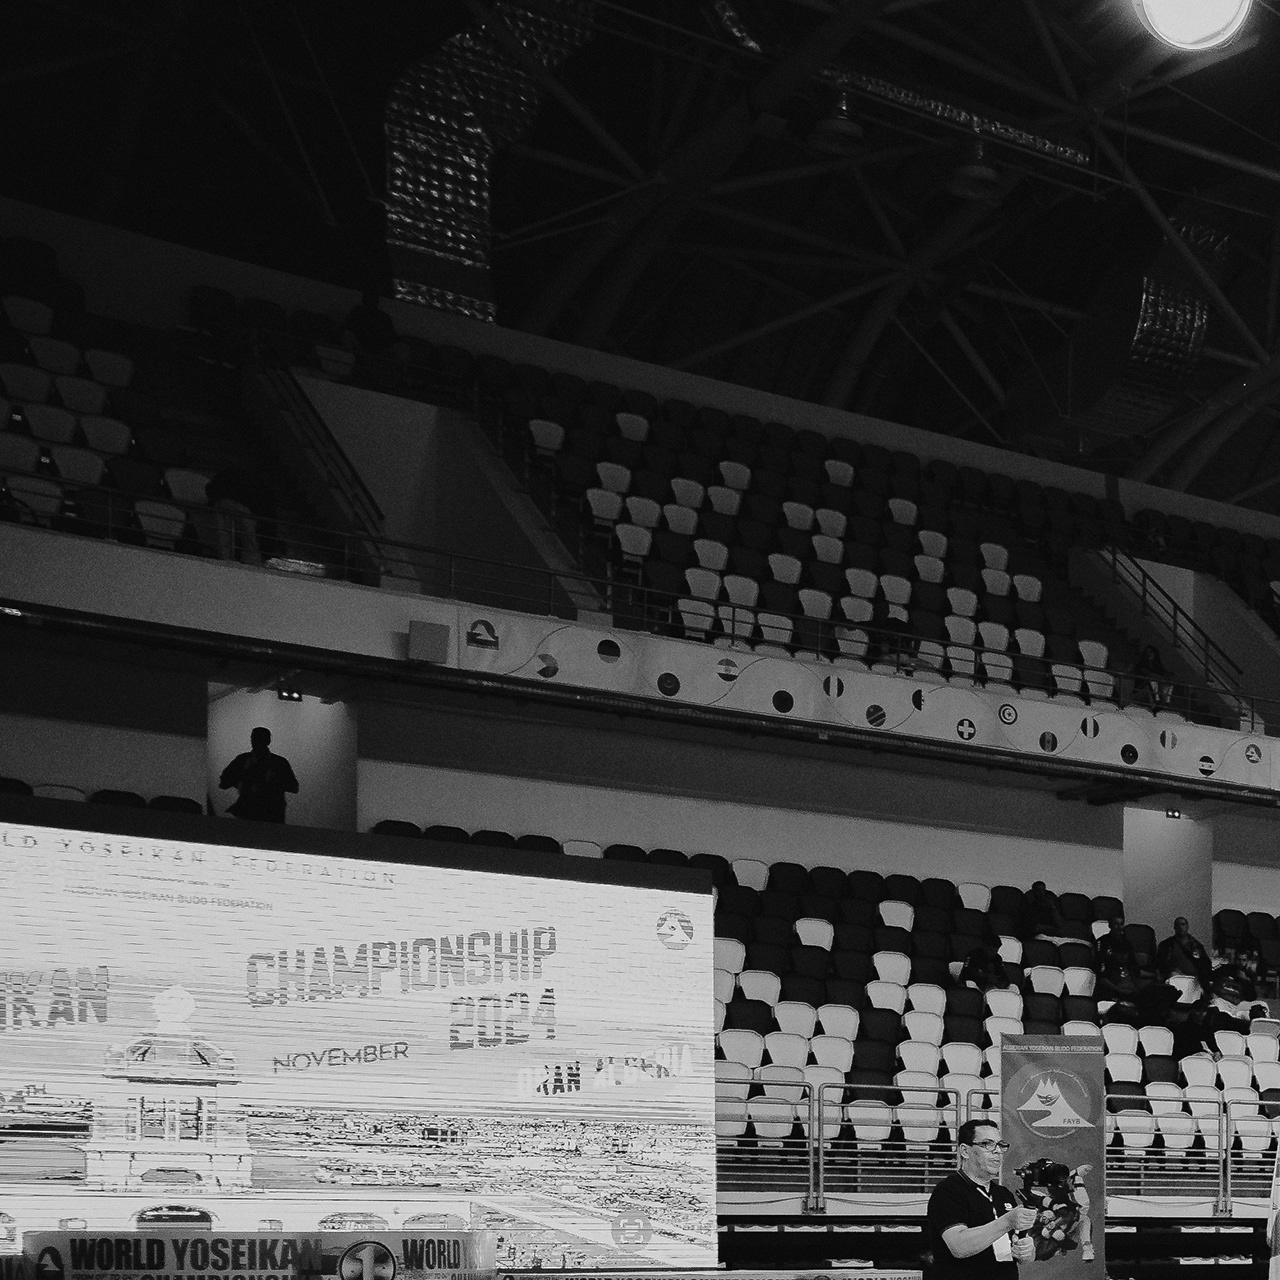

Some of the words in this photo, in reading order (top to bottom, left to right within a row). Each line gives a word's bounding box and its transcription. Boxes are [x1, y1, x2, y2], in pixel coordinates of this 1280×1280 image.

[246, 926, 557, 1008] CHAMPIONSHIP
[450, 987, 557, 1051] 2024
[273, 1041, 409, 1074] NOVEMBER
[69, 1238, 166, 1271] WORLD
[171, 1238, 322, 1271] YOSEIKAN
[402, 1239, 461, 1270] WORLD
